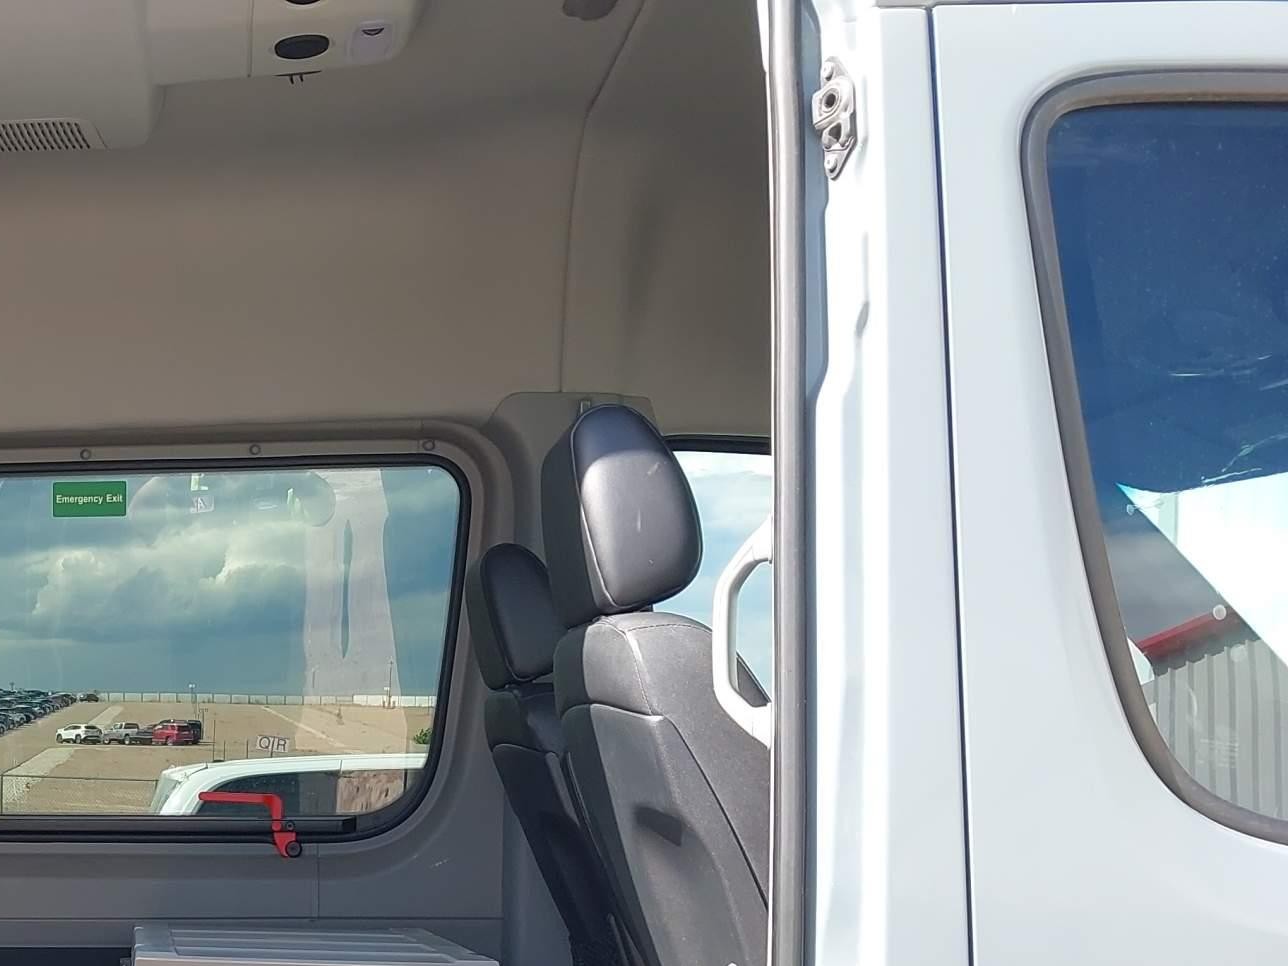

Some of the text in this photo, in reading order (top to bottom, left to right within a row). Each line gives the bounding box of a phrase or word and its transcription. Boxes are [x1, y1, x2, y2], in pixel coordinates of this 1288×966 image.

[55, 493, 123, 505] Emergency Exit
[259, 736, 271, 750] Q
